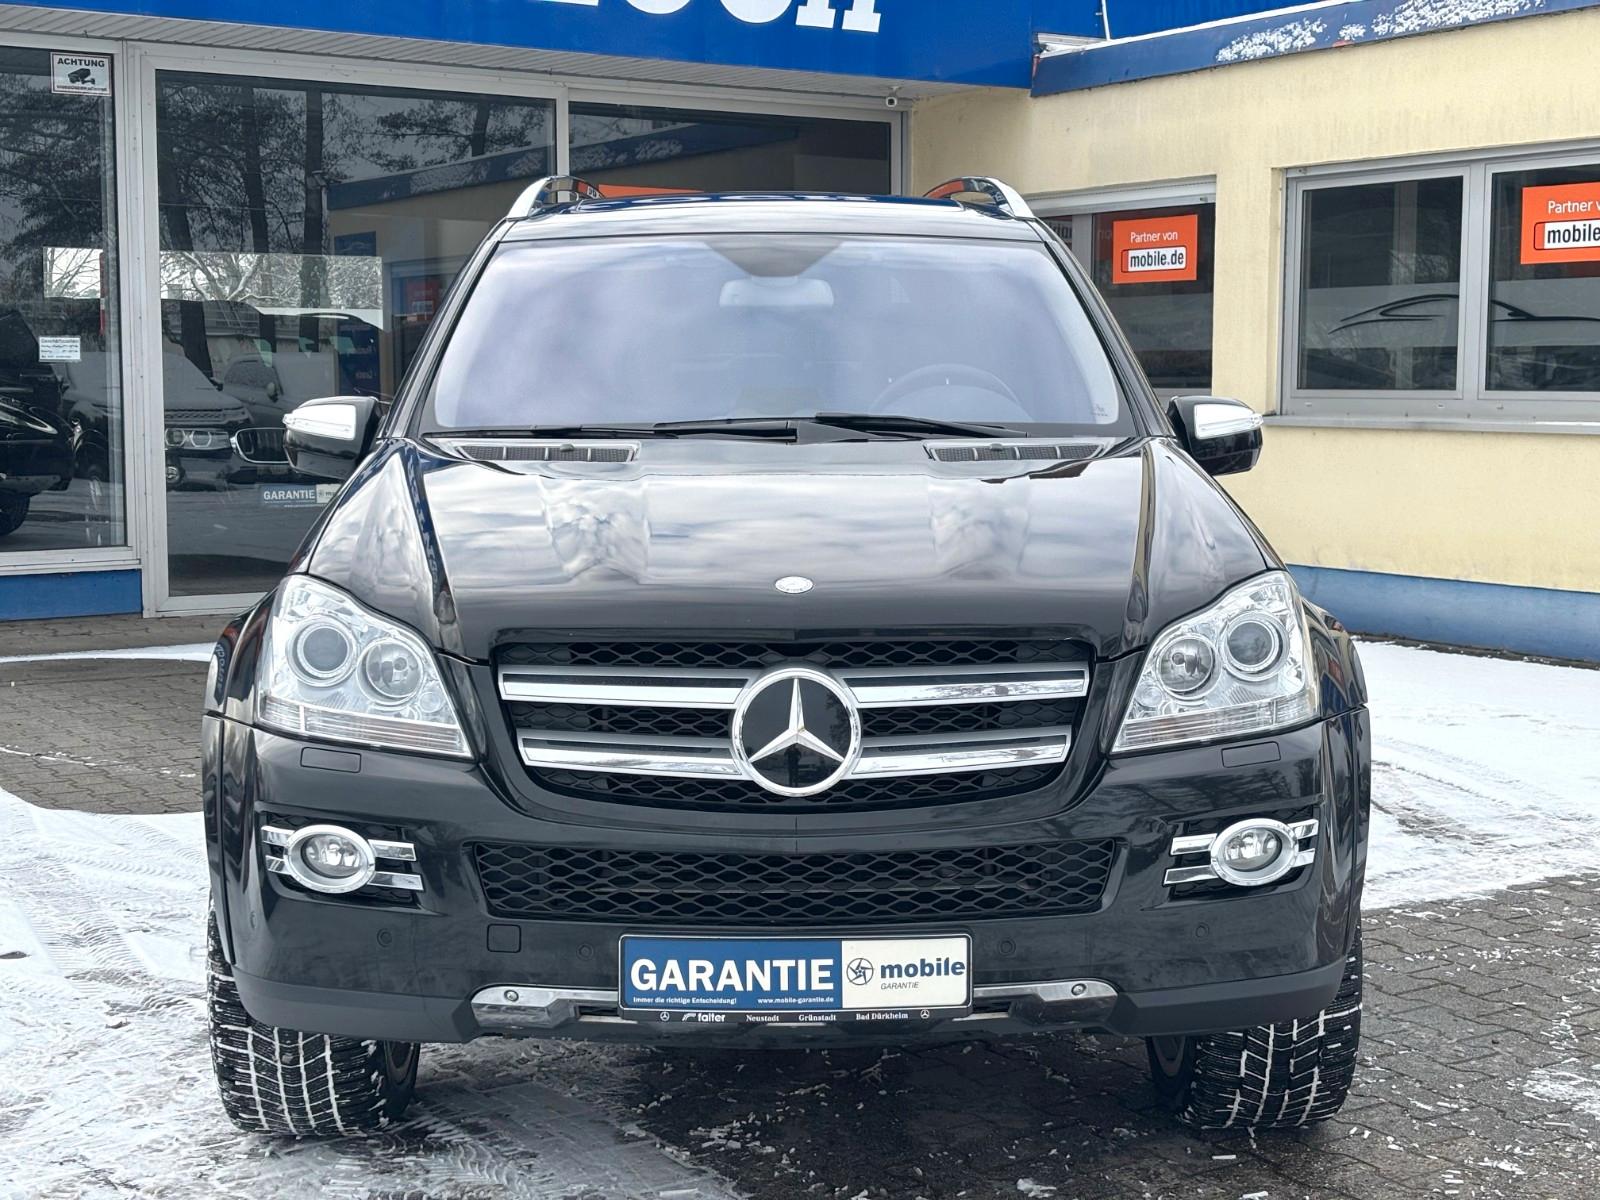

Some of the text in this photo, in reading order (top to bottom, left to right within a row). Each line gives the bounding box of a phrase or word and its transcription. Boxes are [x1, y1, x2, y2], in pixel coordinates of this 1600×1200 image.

[57, 58, 105, 68] ACHTUNG
[1548, 200, 1594, 214] Partner
[1130, 231, 1178, 243] Partner von
[1130, 250, 1184, 268] mobile.de
[263, 490, 316, 500] GARANTIE
[881, 957, 965, 979] mobile
[630, 958, 834, 992] GARANTIE
[666, 996, 690, 1005] richtige
[692, 996, 737, 1005] Entscheidung!
[757, 996, 834, 1004] www.mobile-garantie.de
[745, 1014, 780, 1022] Neustadt
[798, 1013, 837, 1022] Grünstadt
[855, 1012, 909, 1021] Bad Dürkheim
